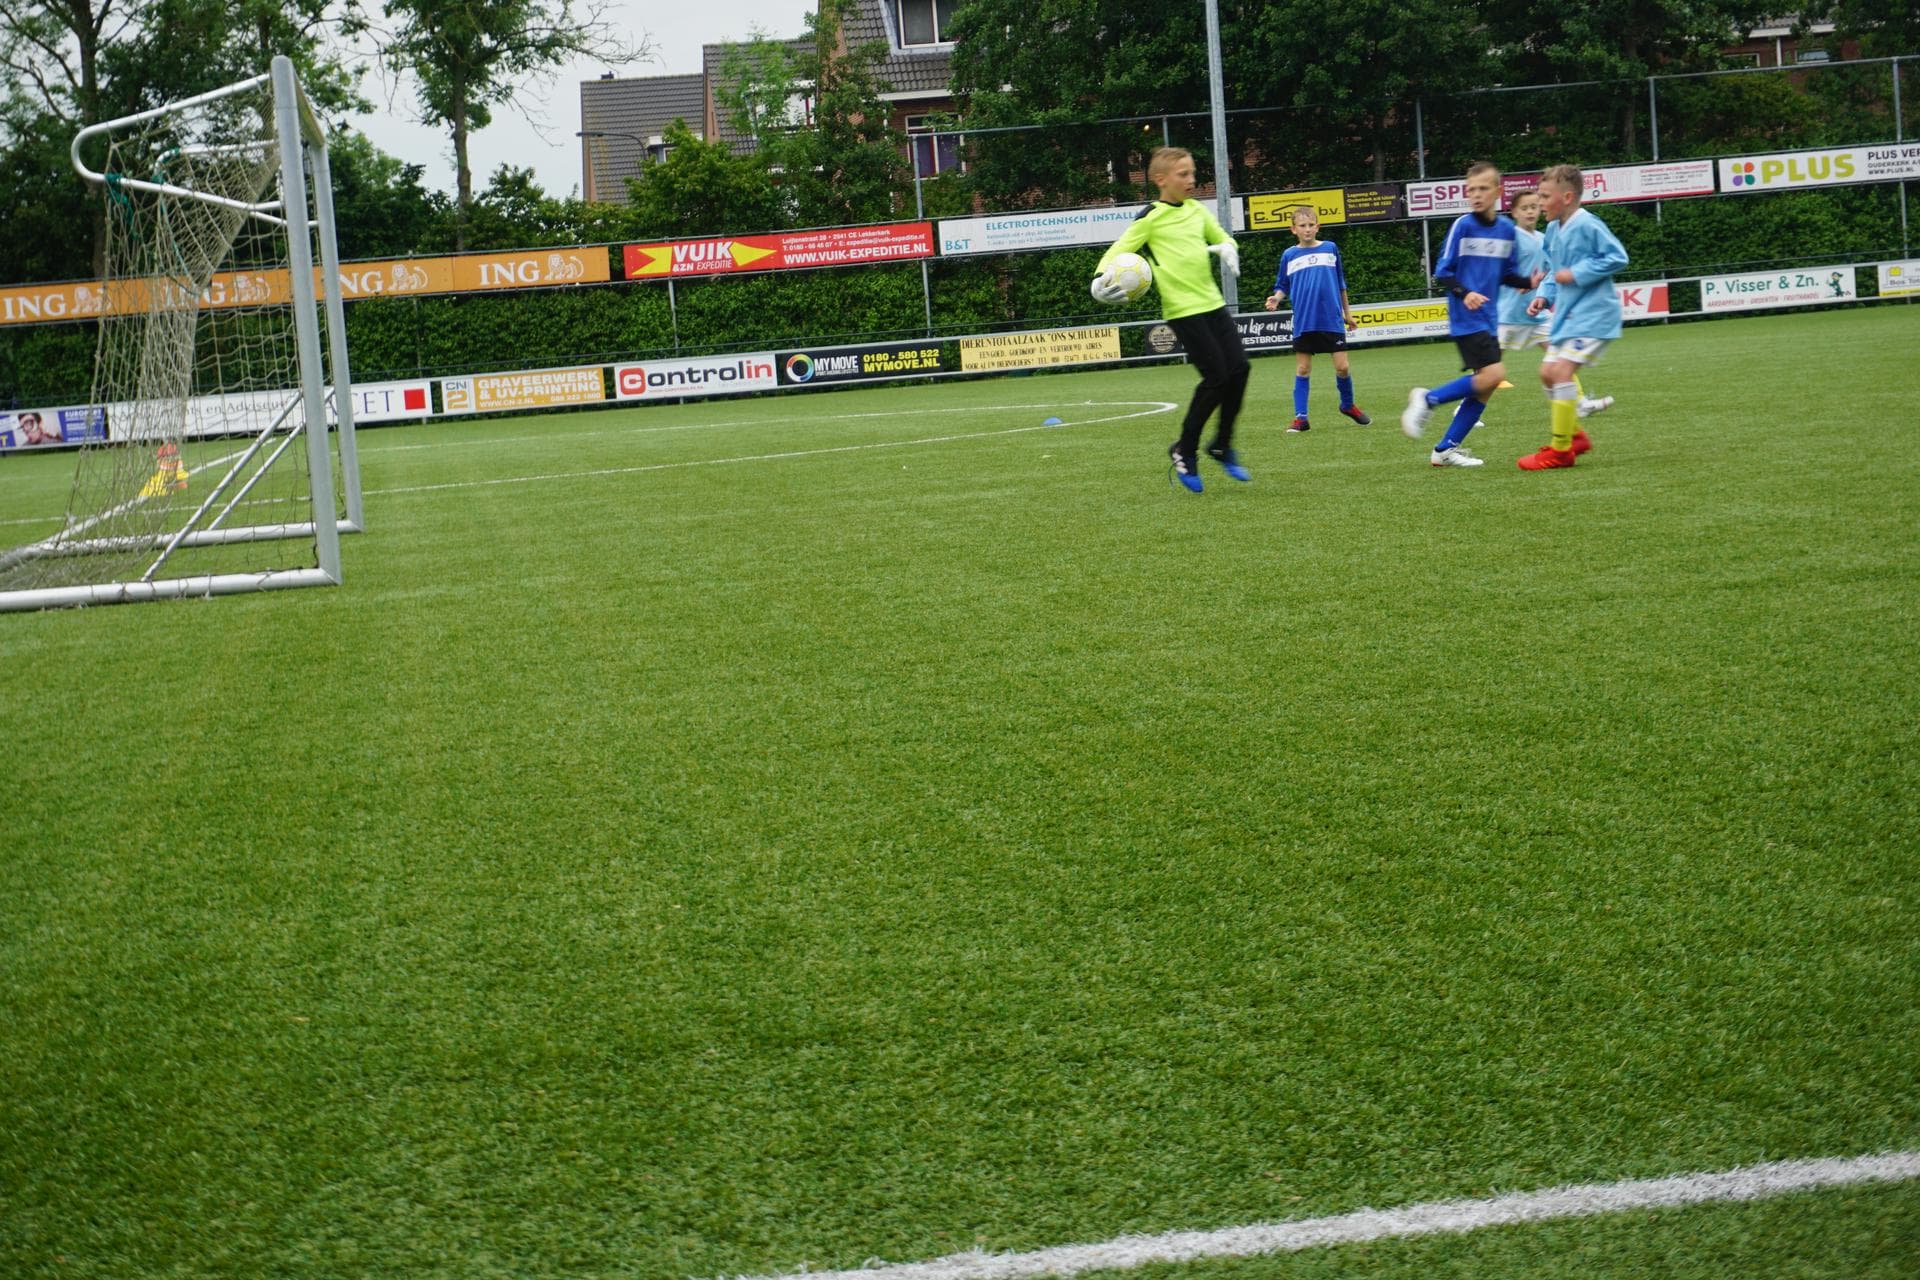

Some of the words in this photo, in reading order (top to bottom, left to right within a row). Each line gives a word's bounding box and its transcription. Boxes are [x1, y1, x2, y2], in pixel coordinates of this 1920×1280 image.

[1868, 150, 1898, 160] PLUS
[1761, 154, 1856, 184] PLUS
[1434, 184, 1470, 201] SPE
[1318, 207, 1342, 216] b.v.
[986, 215, 1087, 231] ELECTROTECHNISCH
[673, 241, 733, 263] VUIK
[784, 243, 930, 264] WWW.VUIK-EXPEDITIE.NL
[945, 238, 971, 251] B&T
[478, 260, 541, 286] ING
[672, 263, 694, 273] &ZN
[696, 259, 732, 271] EXPEDITIE
[164, 276, 226, 306] IG
[339, 270, 384, 295] NG
[1706, 281, 1720, 295] P.
[1725, 278, 1773, 293] Visser
[1778, 275, 1790, 289] &
[1795, 274, 1819, 288] Zn.
[3, 293, 67, 321] ING
[1347, 307, 1450, 325] CCUCENTRA
[1280, 315, 1294, 331] wil
[962, 333, 1046, 349] DIERENTOTAALZAAK
[814, 357, 830, 372] MY
[830, 355, 858, 371] MOVE
[863, 353, 889, 363] 0180
[898, 350, 918, 360] 580
[920, 348, 940, 358] 522
[864, 357, 941, 373] MYMOVE.NL
[445, 380, 467, 391] CN
[478, 370, 599, 390] GRAVEERWERK
[619, 360, 773, 395] Controlin
[446, 390, 469, 409] 2
[479, 390, 491, 400] &
[496, 381, 600, 399] UV-PRINTING
